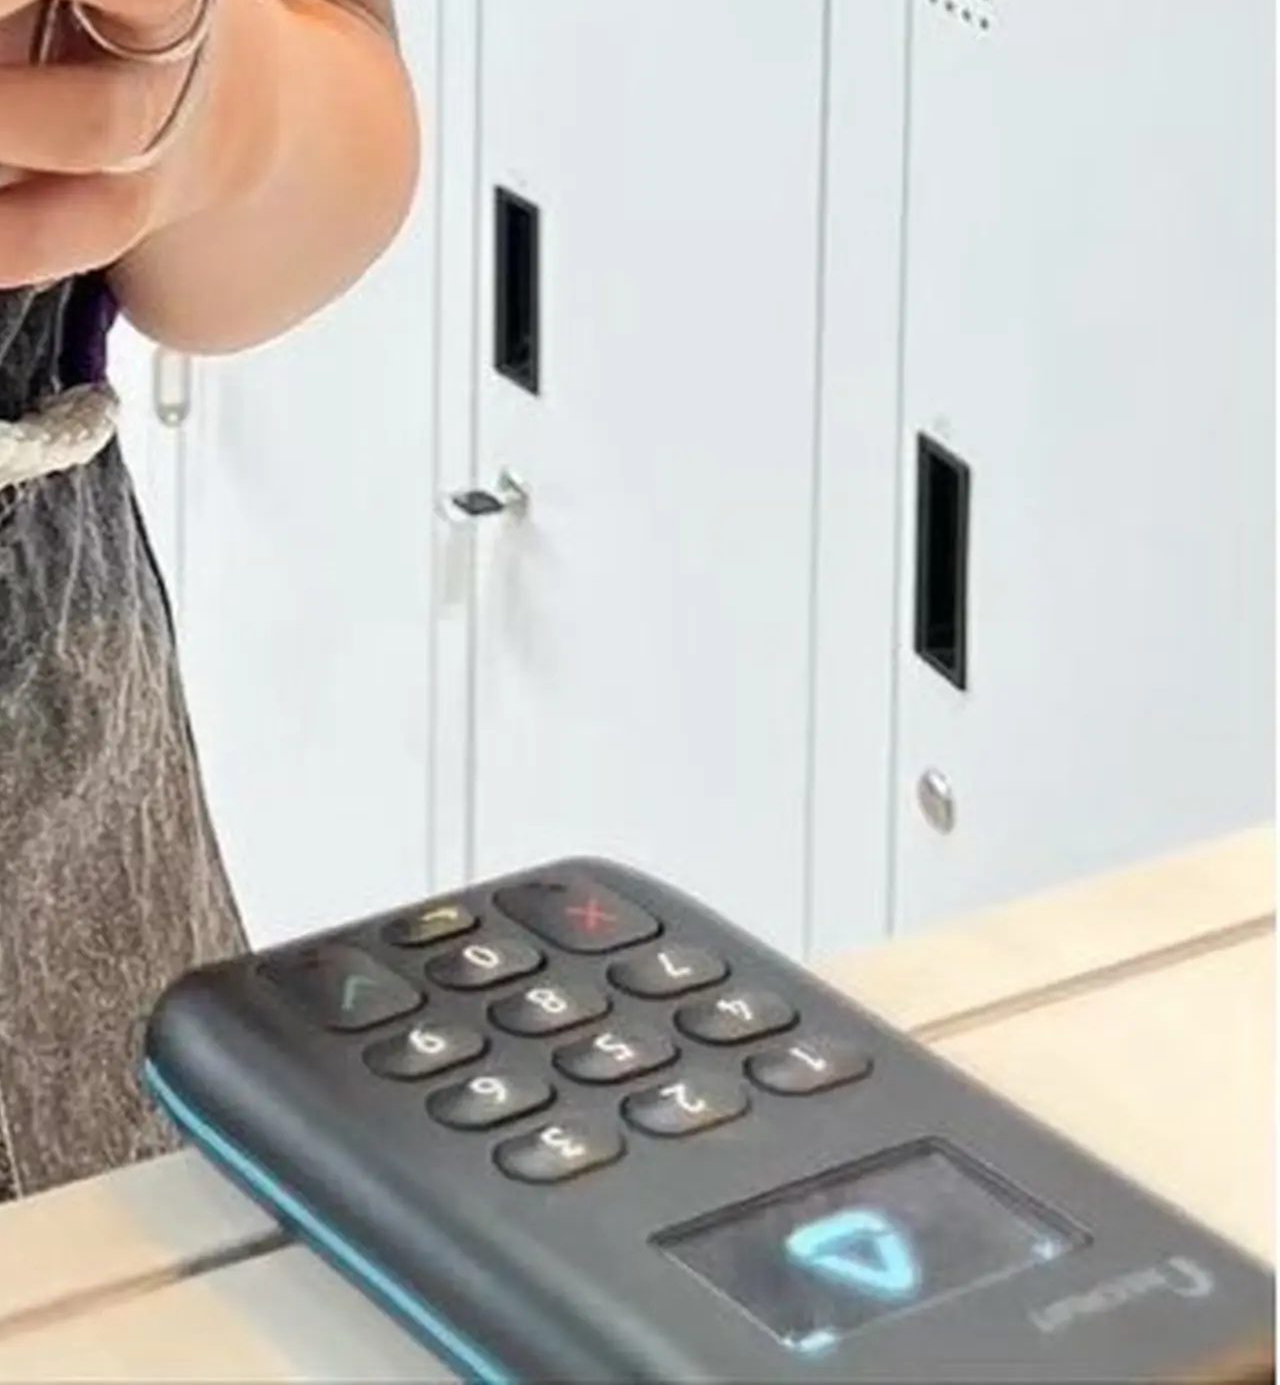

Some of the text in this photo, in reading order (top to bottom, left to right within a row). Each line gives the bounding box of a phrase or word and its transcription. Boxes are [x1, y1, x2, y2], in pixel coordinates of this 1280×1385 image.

[462, 944, 500, 968] 0
[657, 951, 692, 979] 7
[525, 986, 568, 1014] 8
[716, 997, 754, 1022] 4
[408, 1026, 446, 1054] 9
[594, 1032, 636, 1062] 5
[788, 1045, 827, 1072] 1
[469, 1076, 508, 1104] 6
[659, 1082, 707, 1113] 2
[541, 1126, 585, 1159] 3
